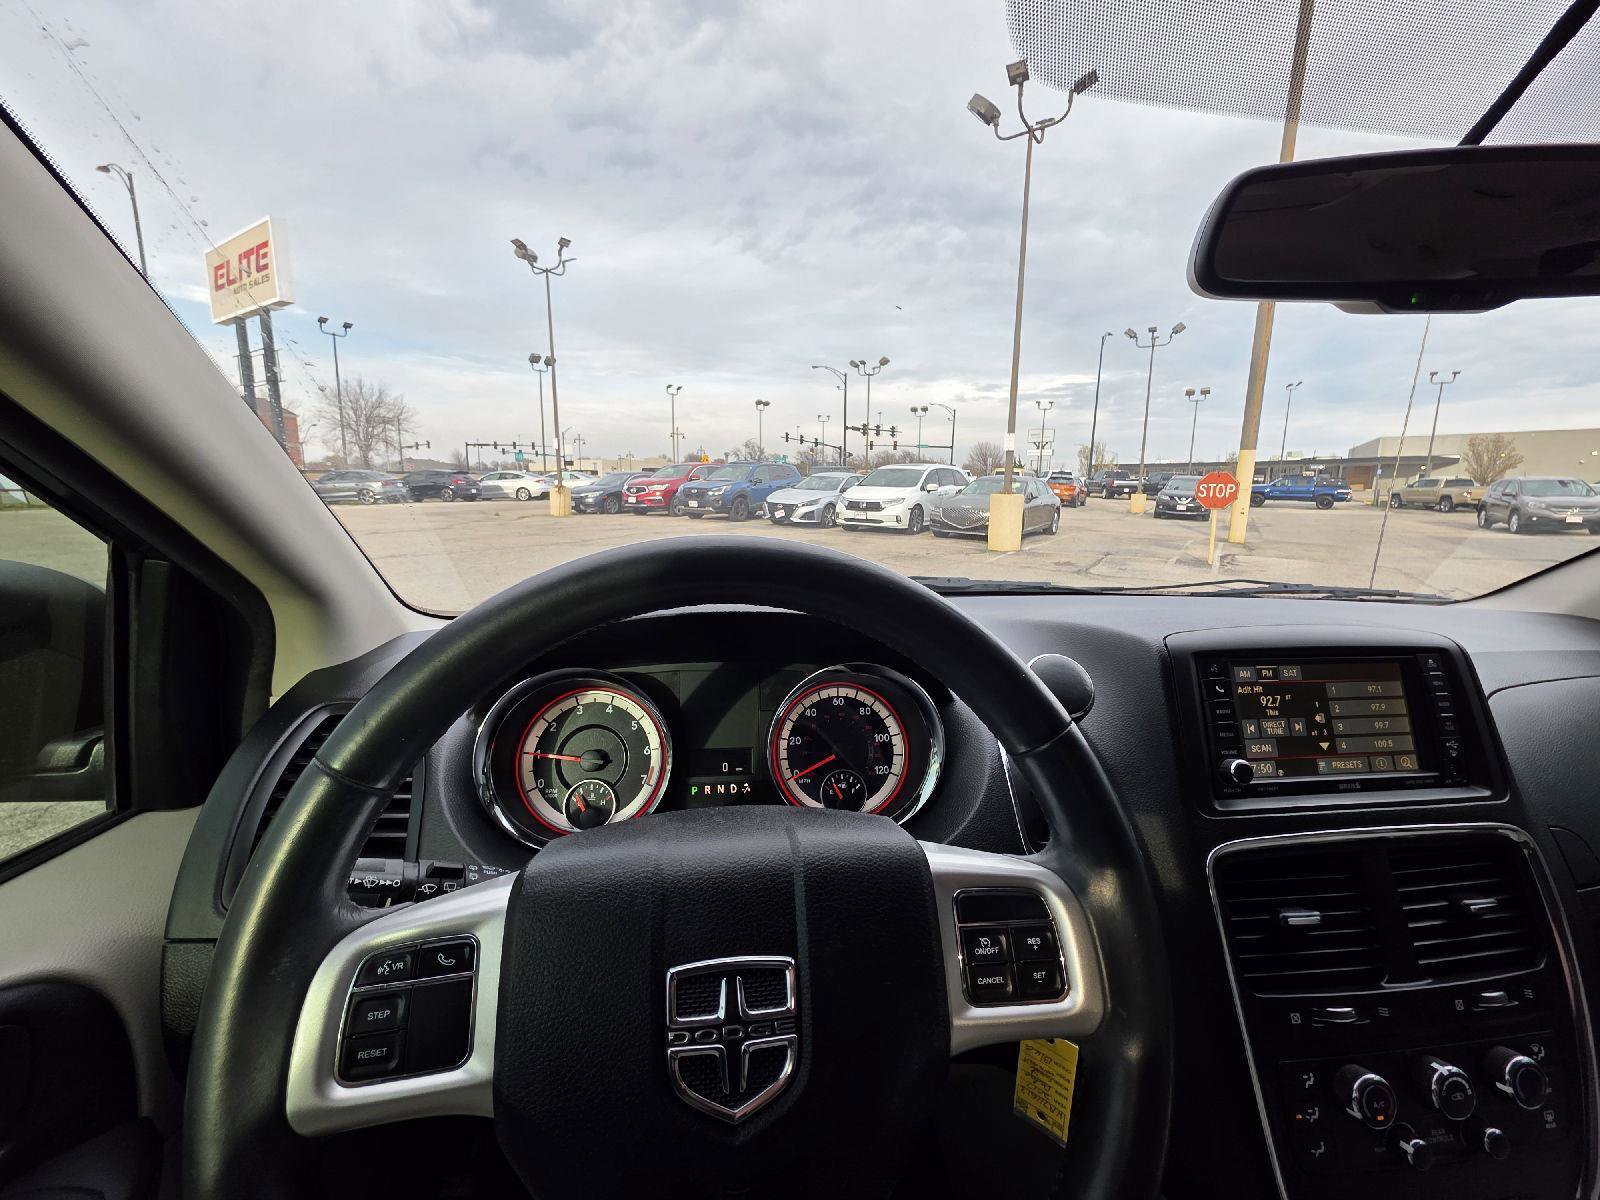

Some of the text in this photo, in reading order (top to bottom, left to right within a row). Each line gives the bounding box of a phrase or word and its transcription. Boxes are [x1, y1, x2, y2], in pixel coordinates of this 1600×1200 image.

[214, 240, 269, 292] ELITE
[233, 274, 270, 295] AUTO SALES
[1198, 484, 1236, 498] STOP
[833, 697, 844, 706] 60
[1260, 696, 1280, 707] 92.7
[576, 707, 583, 715] 3
[804, 708, 817, 717] 40
[859, 707, 871, 715] 80
[550, 722, 557, 732] 2
[631, 721, 638, 730] 5
[790, 736, 802, 745] 20
[874, 734, 890, 743] 100
[644, 746, 650, 755] 6
[722, 763, 728, 771] 0
[1332, 760, 1362, 768] PRESETS
[874, 766, 889, 774] 120
[537, 779, 544, 788] 0
[640, 775, 646, 784] 7
[692, 784, 737, 795] P R N D
[975, 947, 999, 955] ON/OFF
[392, 962, 404, 971] VR
[367, 1010, 390, 1021] STEP
[668, 1019, 796, 1044] DODGE
[358, 1047, 387, 1060] RESET
